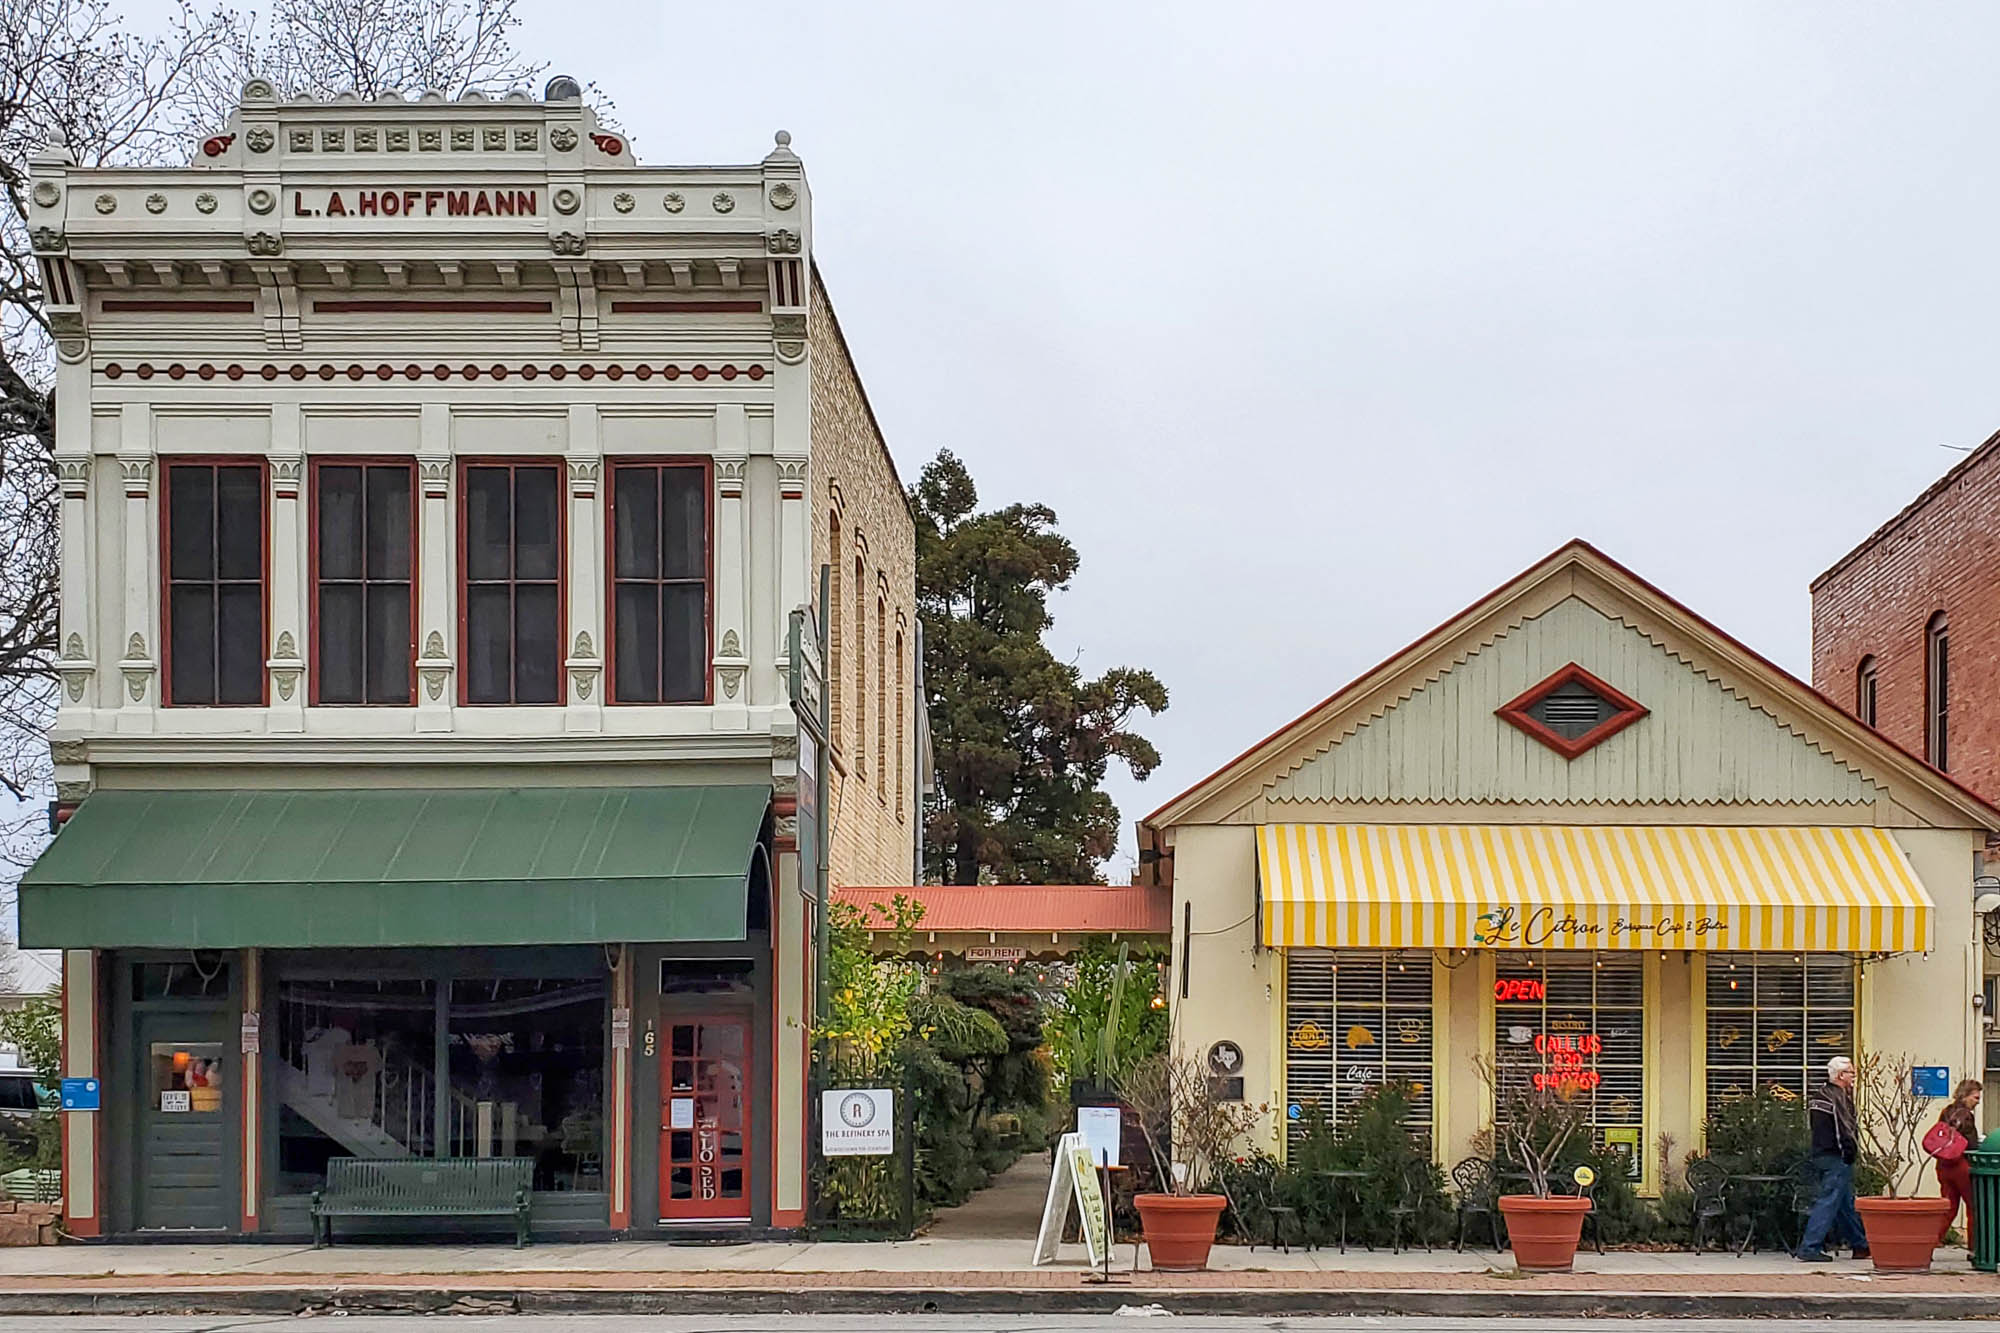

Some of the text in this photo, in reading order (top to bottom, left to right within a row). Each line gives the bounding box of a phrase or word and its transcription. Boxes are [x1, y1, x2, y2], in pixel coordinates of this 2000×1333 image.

[1485, 906, 1520, 946] Le
[1525, 906, 1604, 946] Citron
[970, 948, 1021, 957] FOR RENT
[1494, 979, 1545, 1001] OPEN
[1534, 1034, 1603, 1054] CALL US
[1270, 1089, 1280, 1141] 173
[825, 1129, 890, 1139] THE REFINERY SPA
[699, 1122, 716, 1201] CLOSED
